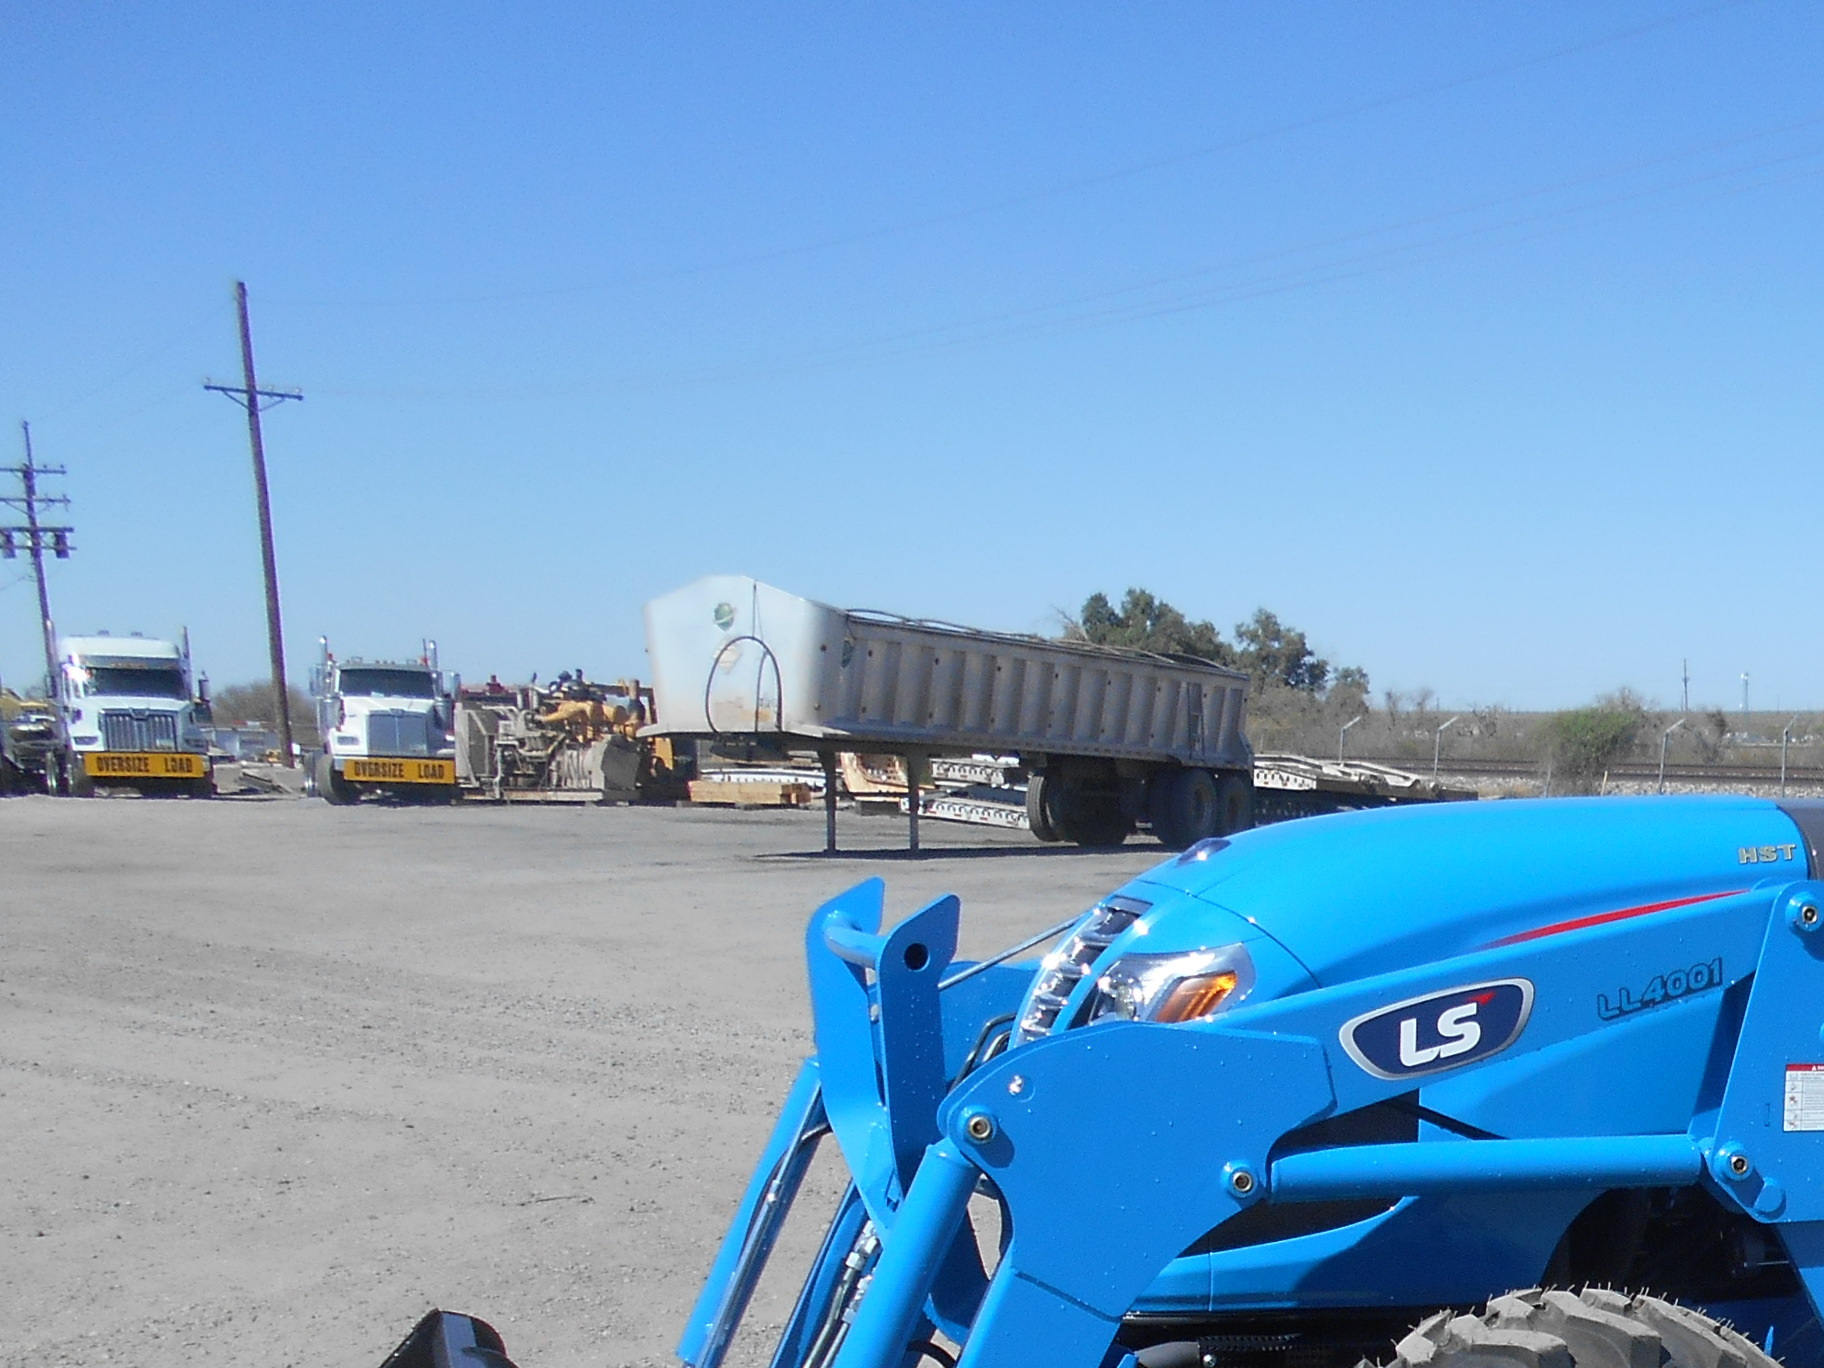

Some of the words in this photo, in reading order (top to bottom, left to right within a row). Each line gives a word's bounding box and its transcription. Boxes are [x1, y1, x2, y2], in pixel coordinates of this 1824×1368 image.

[96, 756, 150, 773] OVERSIZE
[164, 757, 194, 773] LOAD
[354, 761, 404, 778] OVERSIZE
[418, 763, 445, 779] LOAD
[1738, 844, 1797, 864] HST
[1597, 957, 1723, 1021] LL4001
[1400, 1002, 1481, 1067] LS
